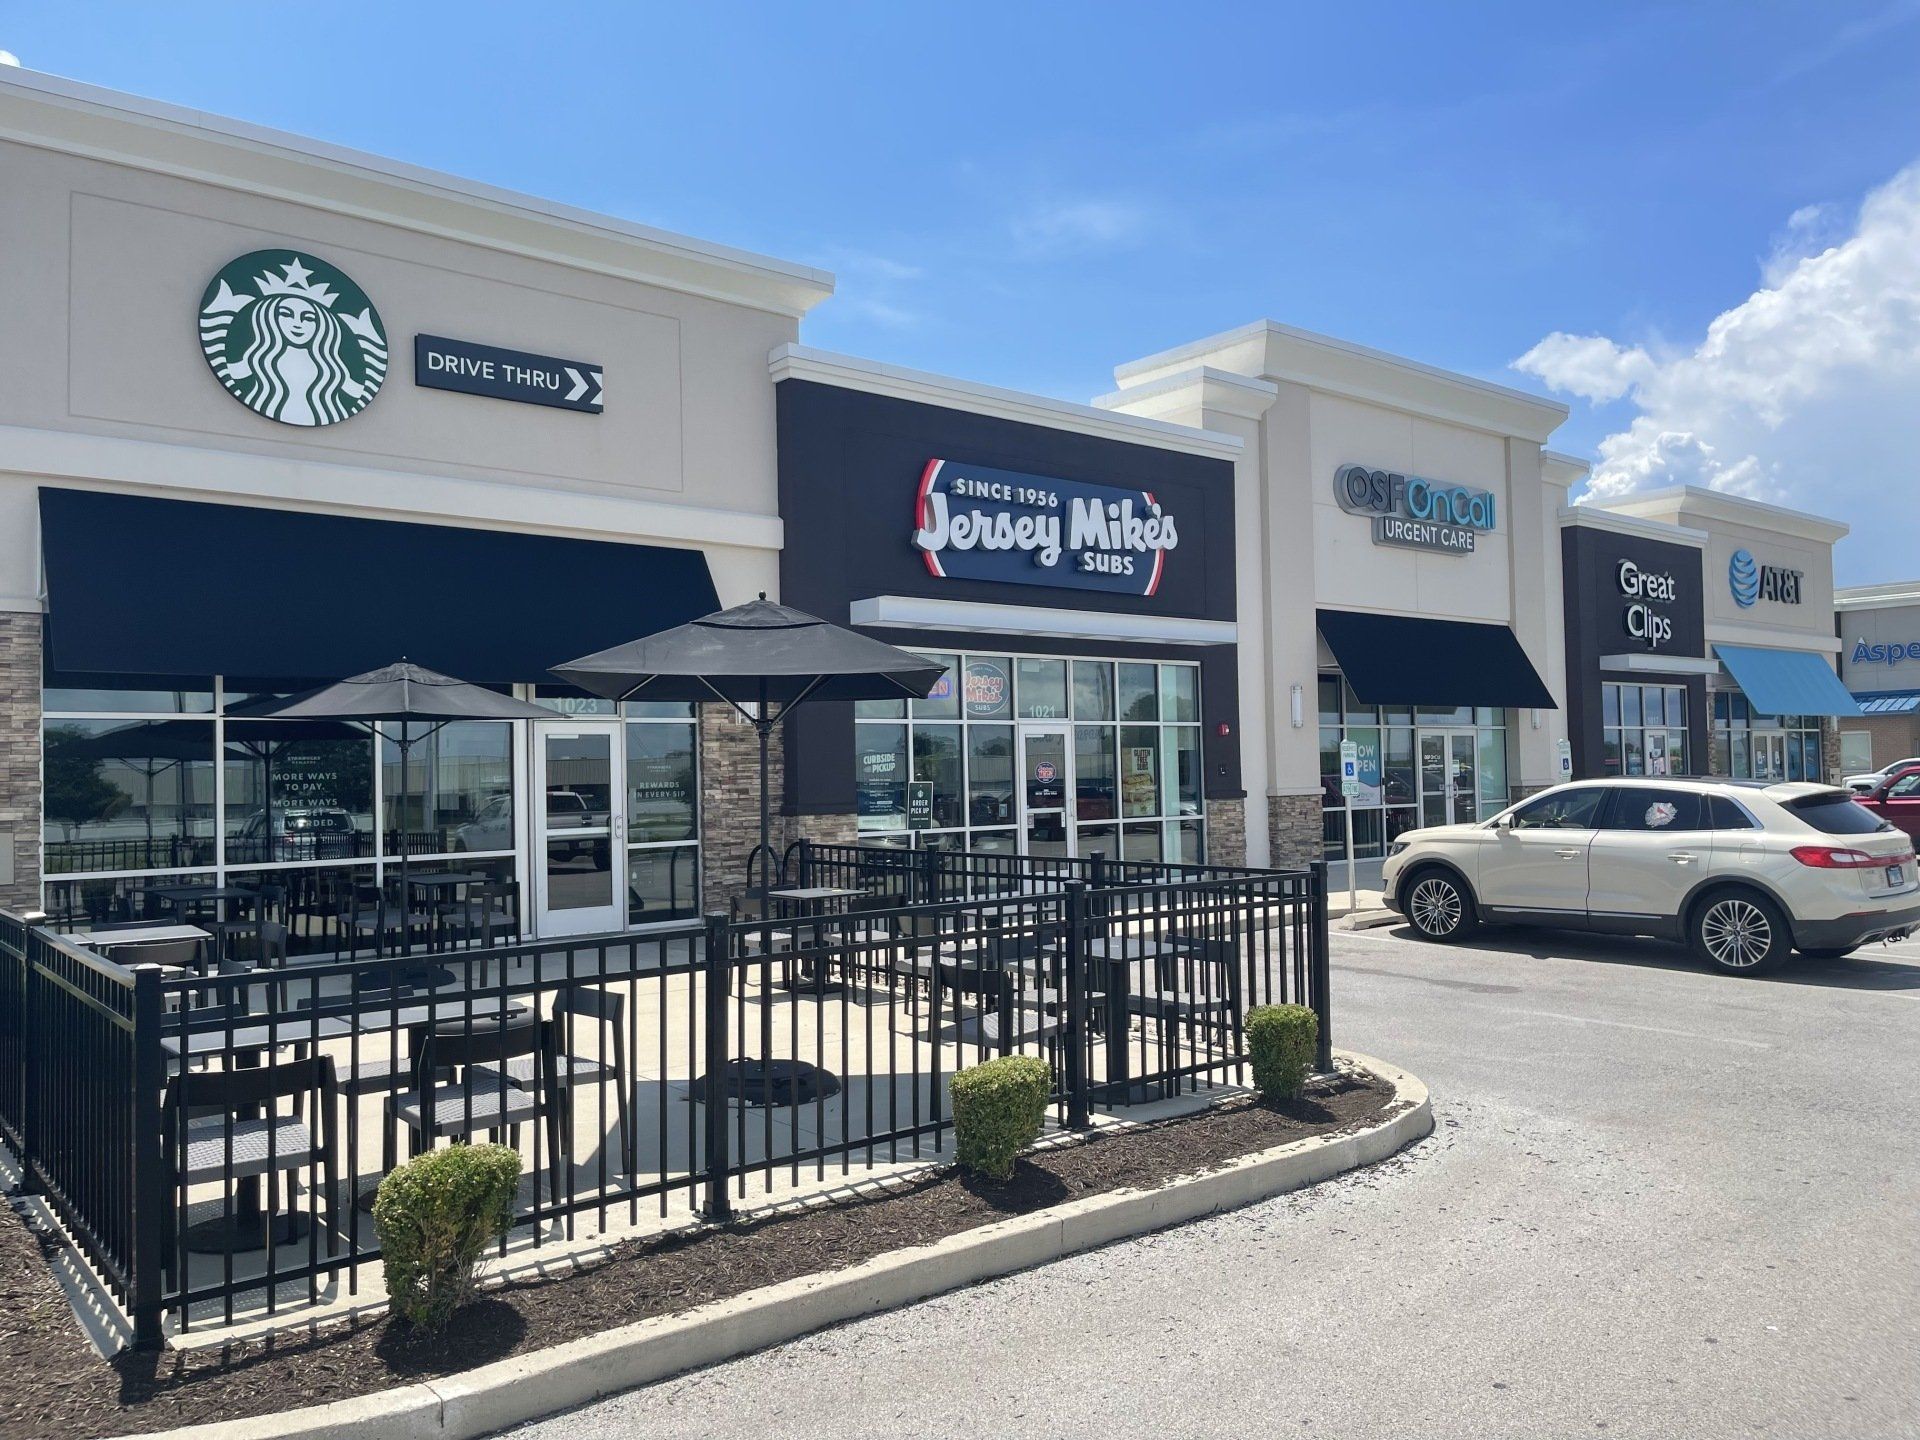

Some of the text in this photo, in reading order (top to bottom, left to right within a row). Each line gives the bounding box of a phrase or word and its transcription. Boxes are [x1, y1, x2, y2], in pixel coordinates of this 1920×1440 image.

[428, 351, 560, 390] DRIVE THRU
[953, 478, 1058, 508] SINCE 1956
[1346, 466, 1496, 530] OSF OnCall
[913, 491, 1179, 567] Jersey Mike's
[1385, 519, 1474, 550] URGENT CARE
[1083, 551, 1134, 576] SUBS
[1619, 560, 1676, 601] Great
[1758, 565, 1804, 605] AT&T
[1626, 603, 1672, 648] Clips
[554, 697, 598, 714] 1023
[1029, 705, 1056, 718] 1021
[863, 752, 896, 765] CURBSIDE
[1357, 744, 1375, 758] OW
[871, 762, 896, 774] PICKUP
[1357, 759, 1377, 773] PEN
[272, 772, 338, 781] MORE WAYS
[285, 783, 325, 791] TO PAY.
[639, 781, 680, 790] REWARDS
[645, 790, 670, 799] EVERY
[672, 790, 686, 798] SIP
[272, 798, 338, 808] MORE WAYS
